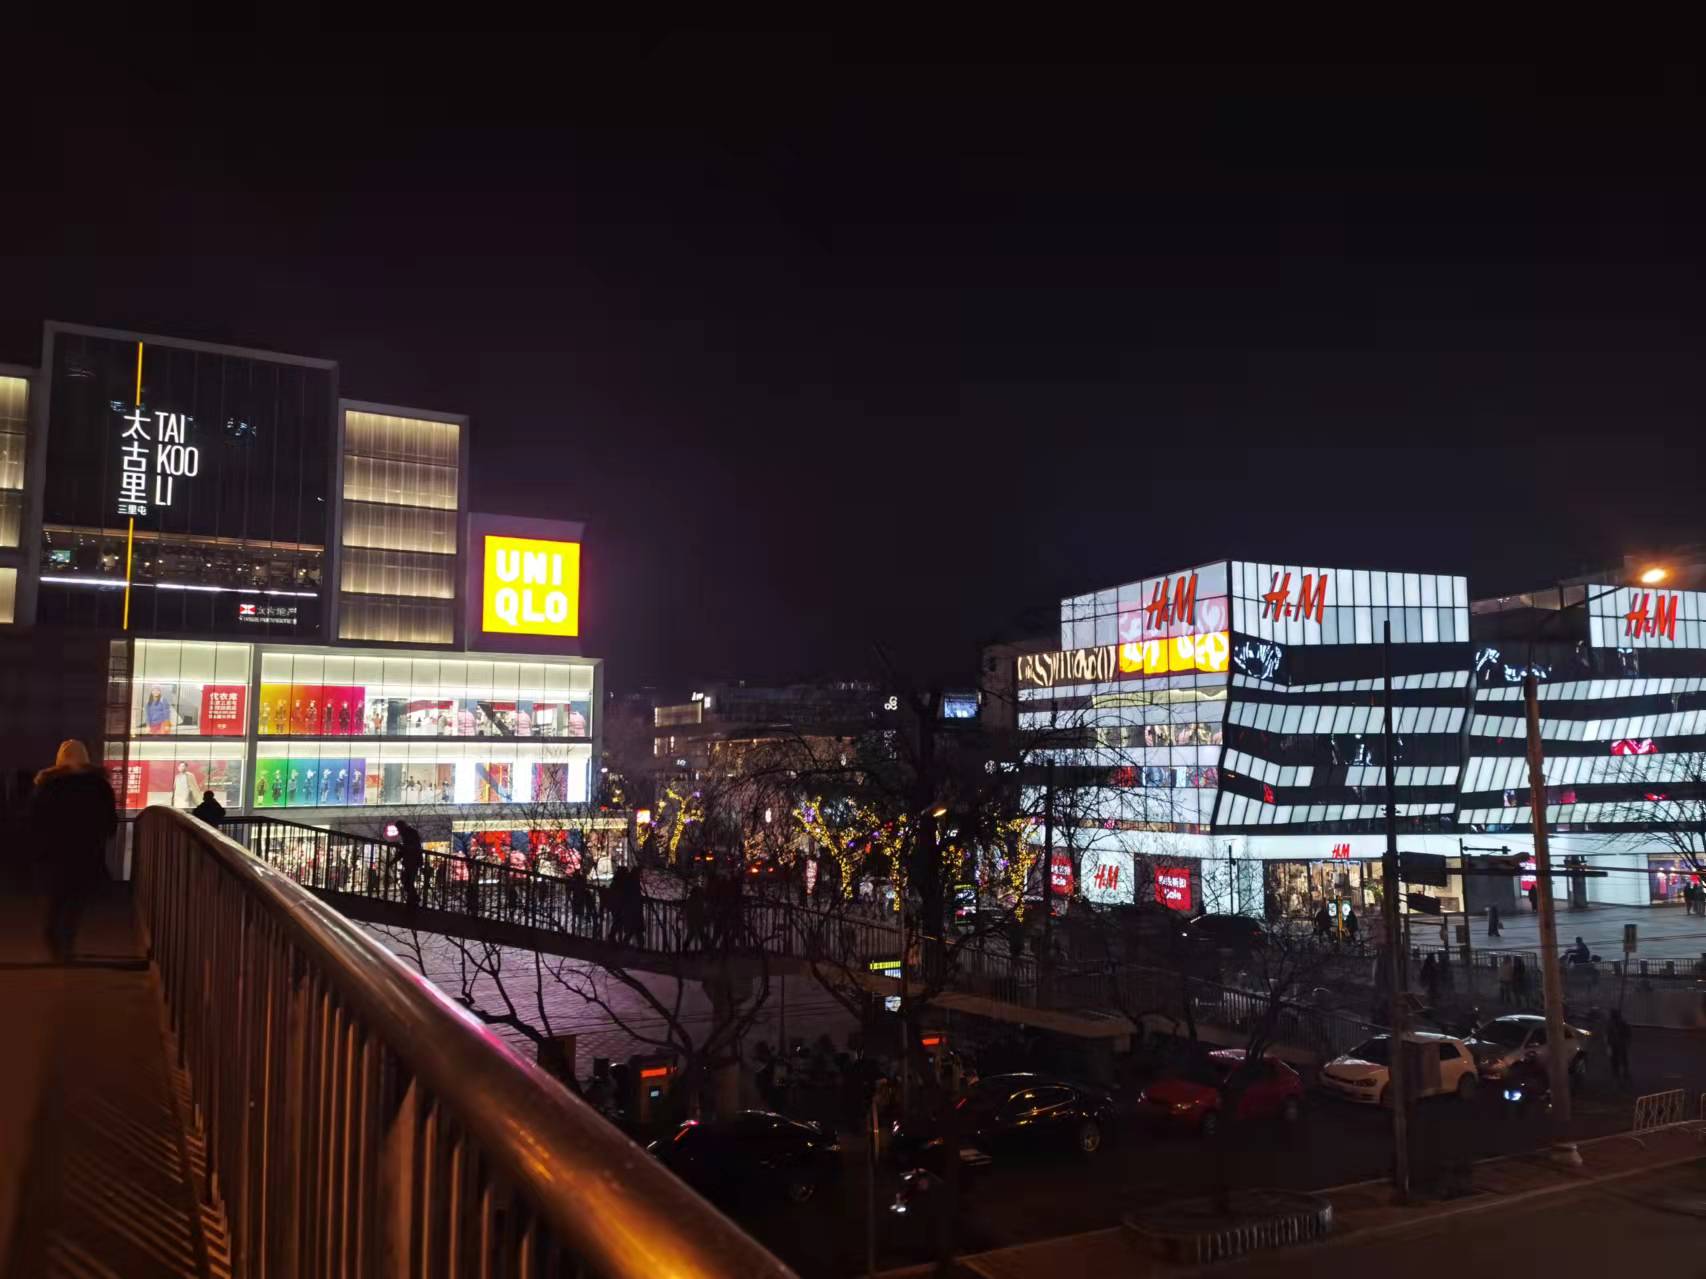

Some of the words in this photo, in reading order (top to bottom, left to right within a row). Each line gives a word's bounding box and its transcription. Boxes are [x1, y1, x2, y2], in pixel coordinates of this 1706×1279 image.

[154, 411, 185, 444] TAI
[118, 409, 151, 504] 太古里
[157, 443, 199, 478] KOO
[155, 475, 173, 506] LI
[117, 504, 148, 516] 三里屯
[495, 549, 563, 585] UNI
[495, 587, 569, 626] QLO
[1145, 573, 1198, 631] H&M
[1262, 571, 1328, 625] H&M
[1624, 592, 1678, 641] H&M
